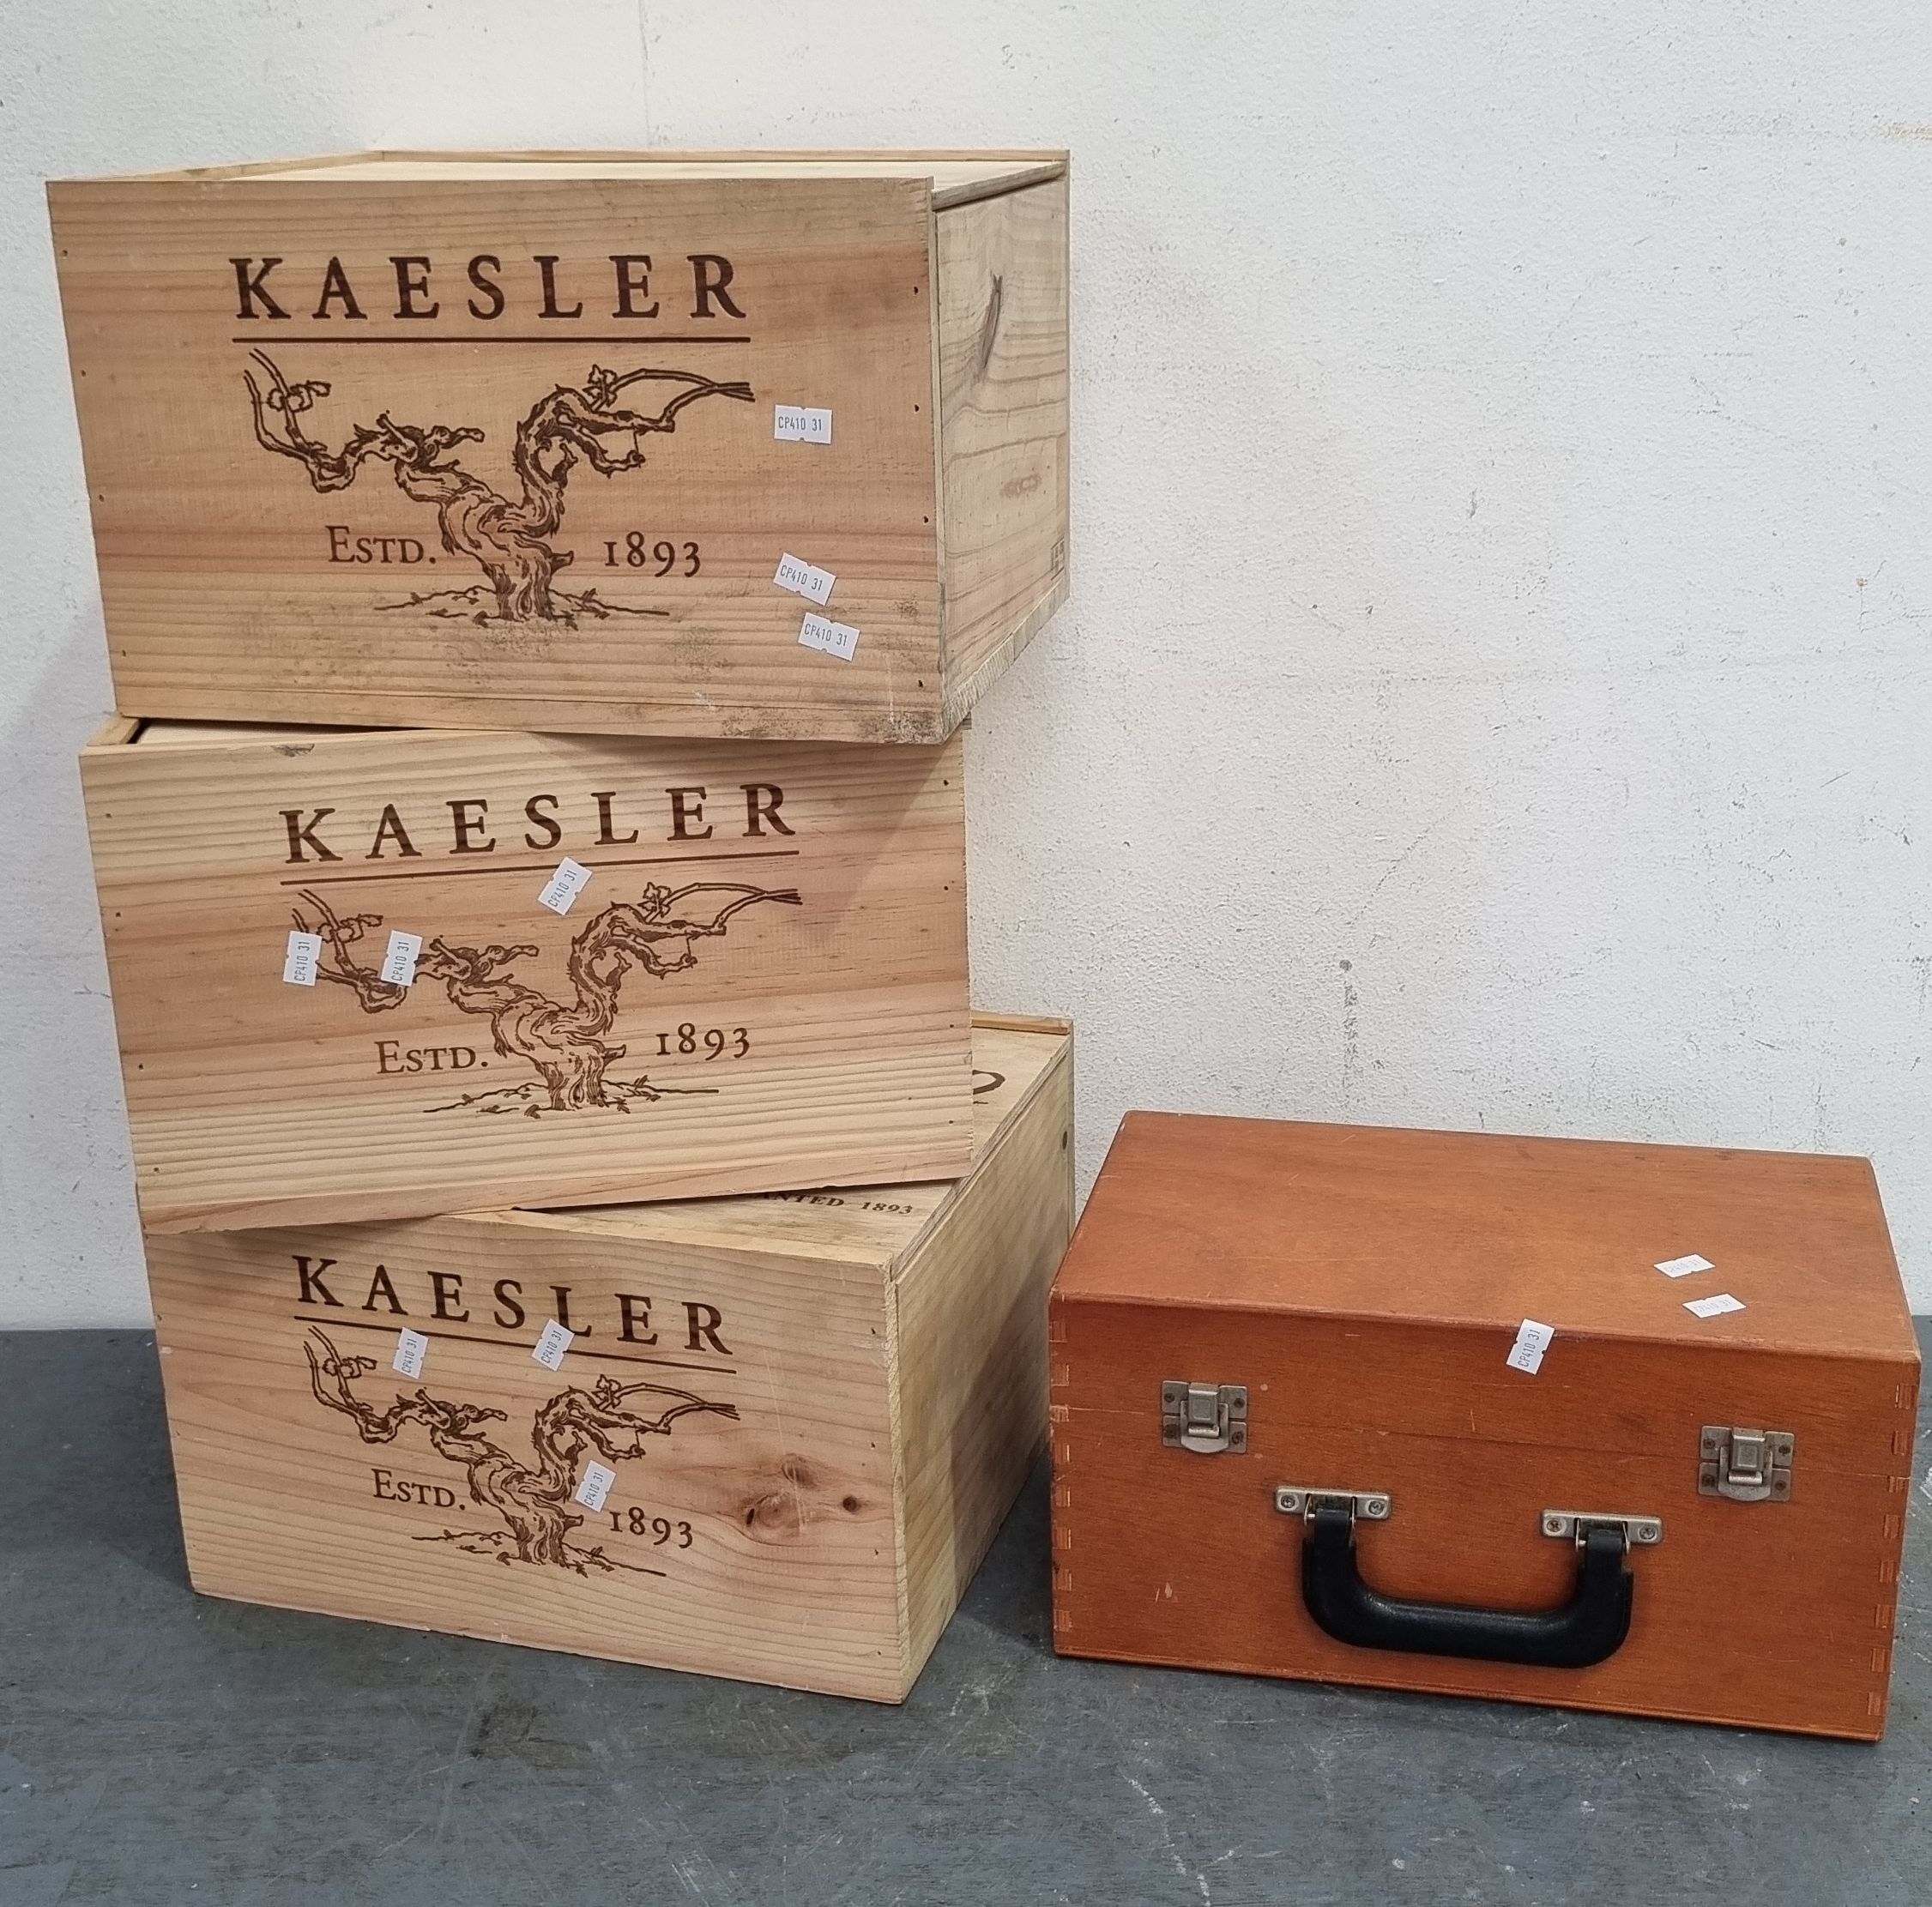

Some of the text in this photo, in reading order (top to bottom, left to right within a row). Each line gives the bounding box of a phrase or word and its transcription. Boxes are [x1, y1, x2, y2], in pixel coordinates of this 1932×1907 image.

[229, 255, 747, 320] KAESLER
[778, 416, 822, 431] CP410 31
[603, 530, 701, 577] 1893
[780, 564, 823, 591] CP410 31
[804, 623, 848, 646] CP410 31
[280, 782, 797, 864] KAESLER
[547, 870, 577, 908] CP410 31
[294, 941, 311, 981] CP410 31
[391, 941, 409, 981] CP410 31
[655, 1023, 750, 1061] 1893
[860, 1201, 914, 1215] 1893
[292, 1255, 734, 1356] KAESLER
[401, 1337, 418, 1373] CP410 31
[540, 1330, 563, 1364] CP410 31
[1517, 1329, 1541, 1367] CP410 31
[583, 1471, 604, 1506] CP410 31
[609, 1506, 693, 1549] 1893
